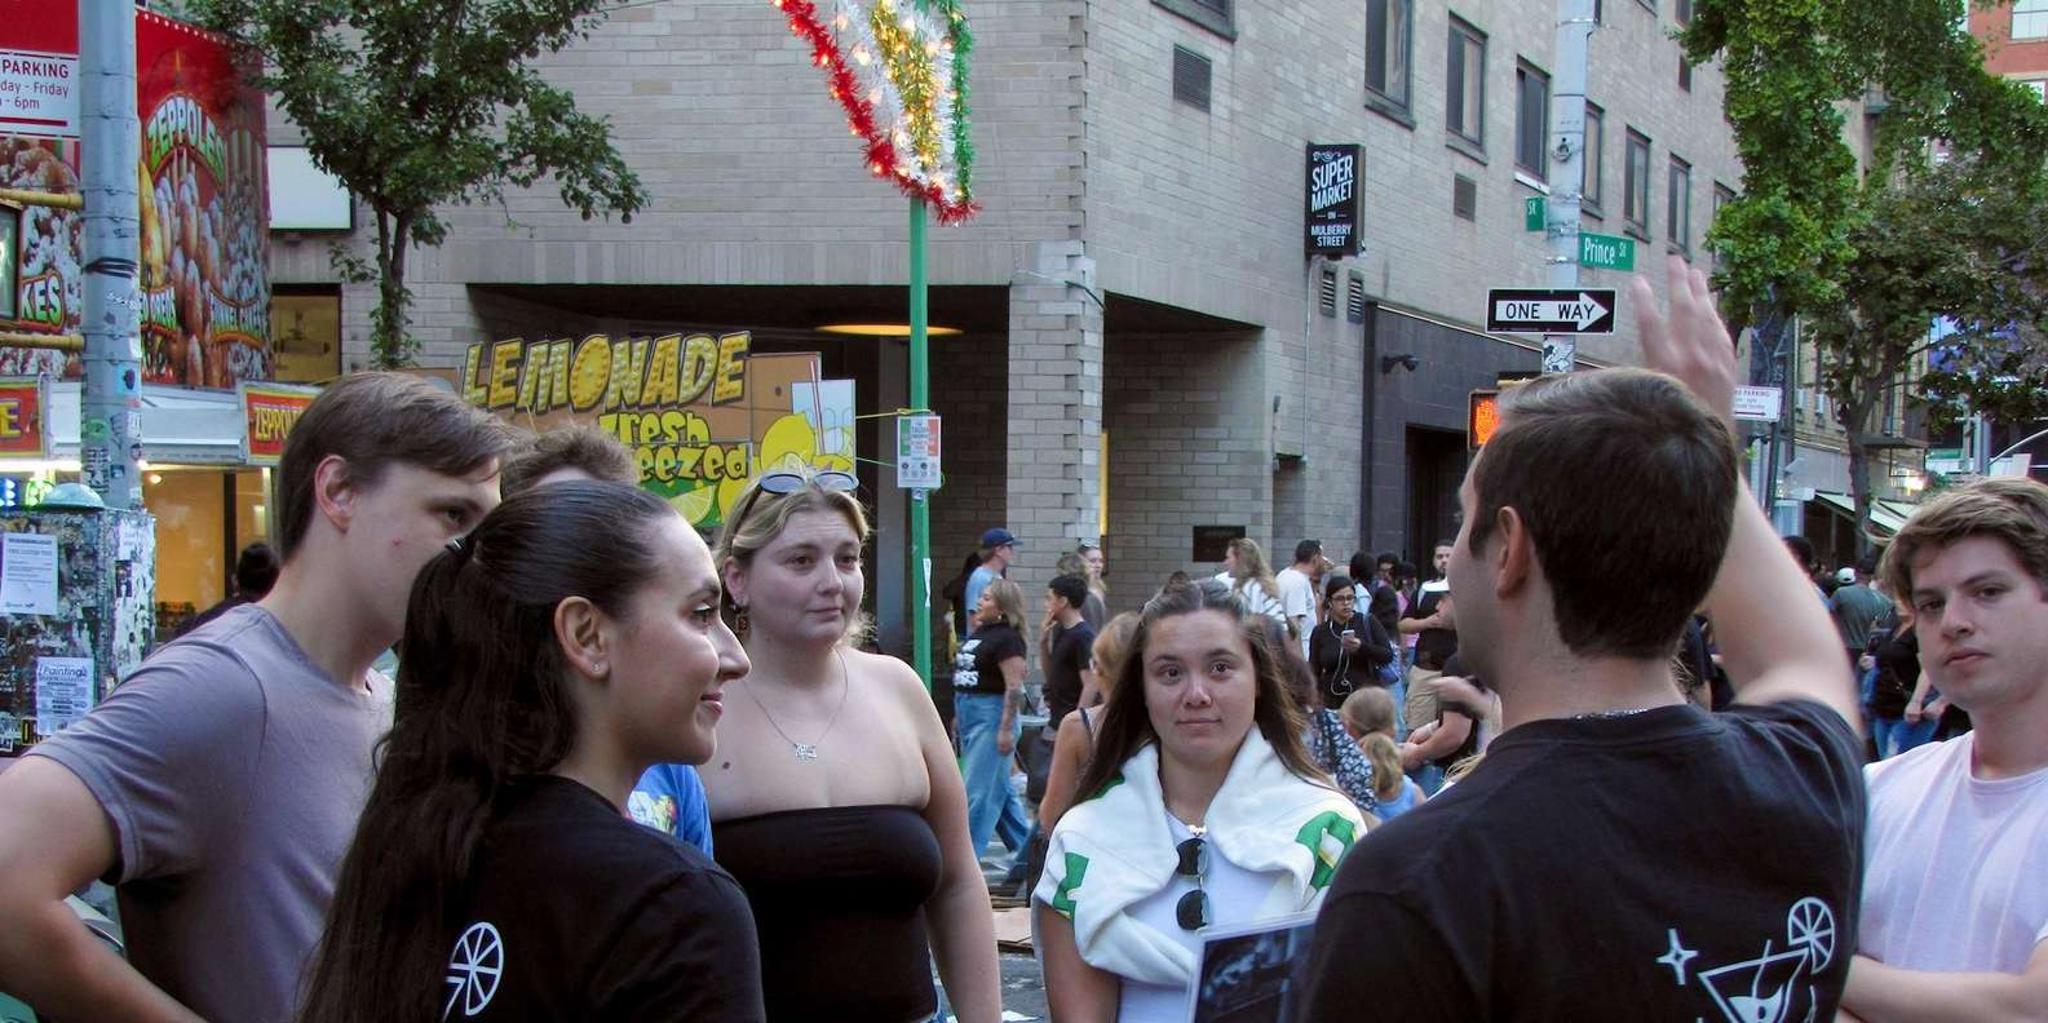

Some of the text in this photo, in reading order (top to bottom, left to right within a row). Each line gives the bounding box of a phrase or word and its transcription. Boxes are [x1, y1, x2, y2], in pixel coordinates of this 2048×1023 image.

[3, 59, 69, 78] PARKING
[0, 80, 20, 95] day
[34, 82, 69, 98] Friday
[15, 96, 40, 109] 6pm
[147, 97, 225, 184] ZEPPOLES
[1312, 155, 1353, 192] SUPER
[1311, 180, 1353, 212] MARKET
[1311, 224, 1352, 236] MULBERRY
[1317, 236, 1345, 247] STREET
[1584, 237, 1616, 264] Prince
[22, 276, 62, 327] KES
[1506, 303, 1595, 319] ONE WAY
[462, 332, 749, 411] LEMONADE
[254, 407, 303, 440] ZEPPO
[634, 444, 748, 482] eezed
